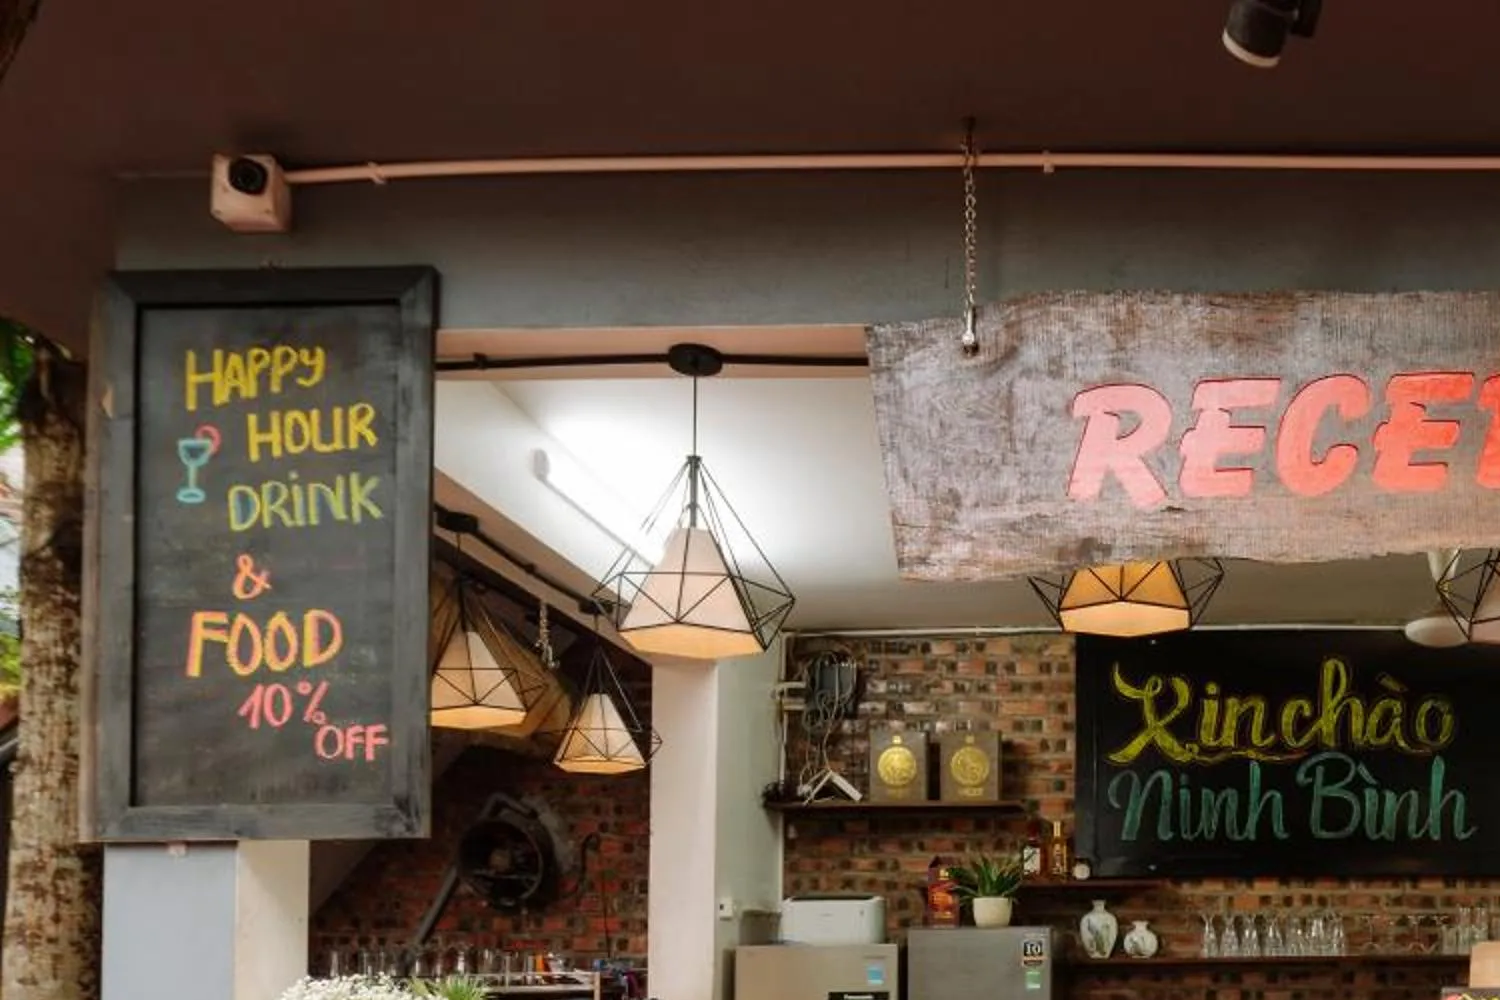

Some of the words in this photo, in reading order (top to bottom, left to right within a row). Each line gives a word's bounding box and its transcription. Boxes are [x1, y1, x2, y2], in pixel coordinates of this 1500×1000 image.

[186, 346, 325, 410] HAPPY
[247, 403, 379, 462] HOUR
[233, 554, 271, 598] &
[187, 609, 342, 676] FOOD
[238, 681, 328, 729] 10%
[314, 724, 389, 761] OFF
[1108, 761, 1290, 841] Ninh
[1297, 752, 1476, 841] Bình
